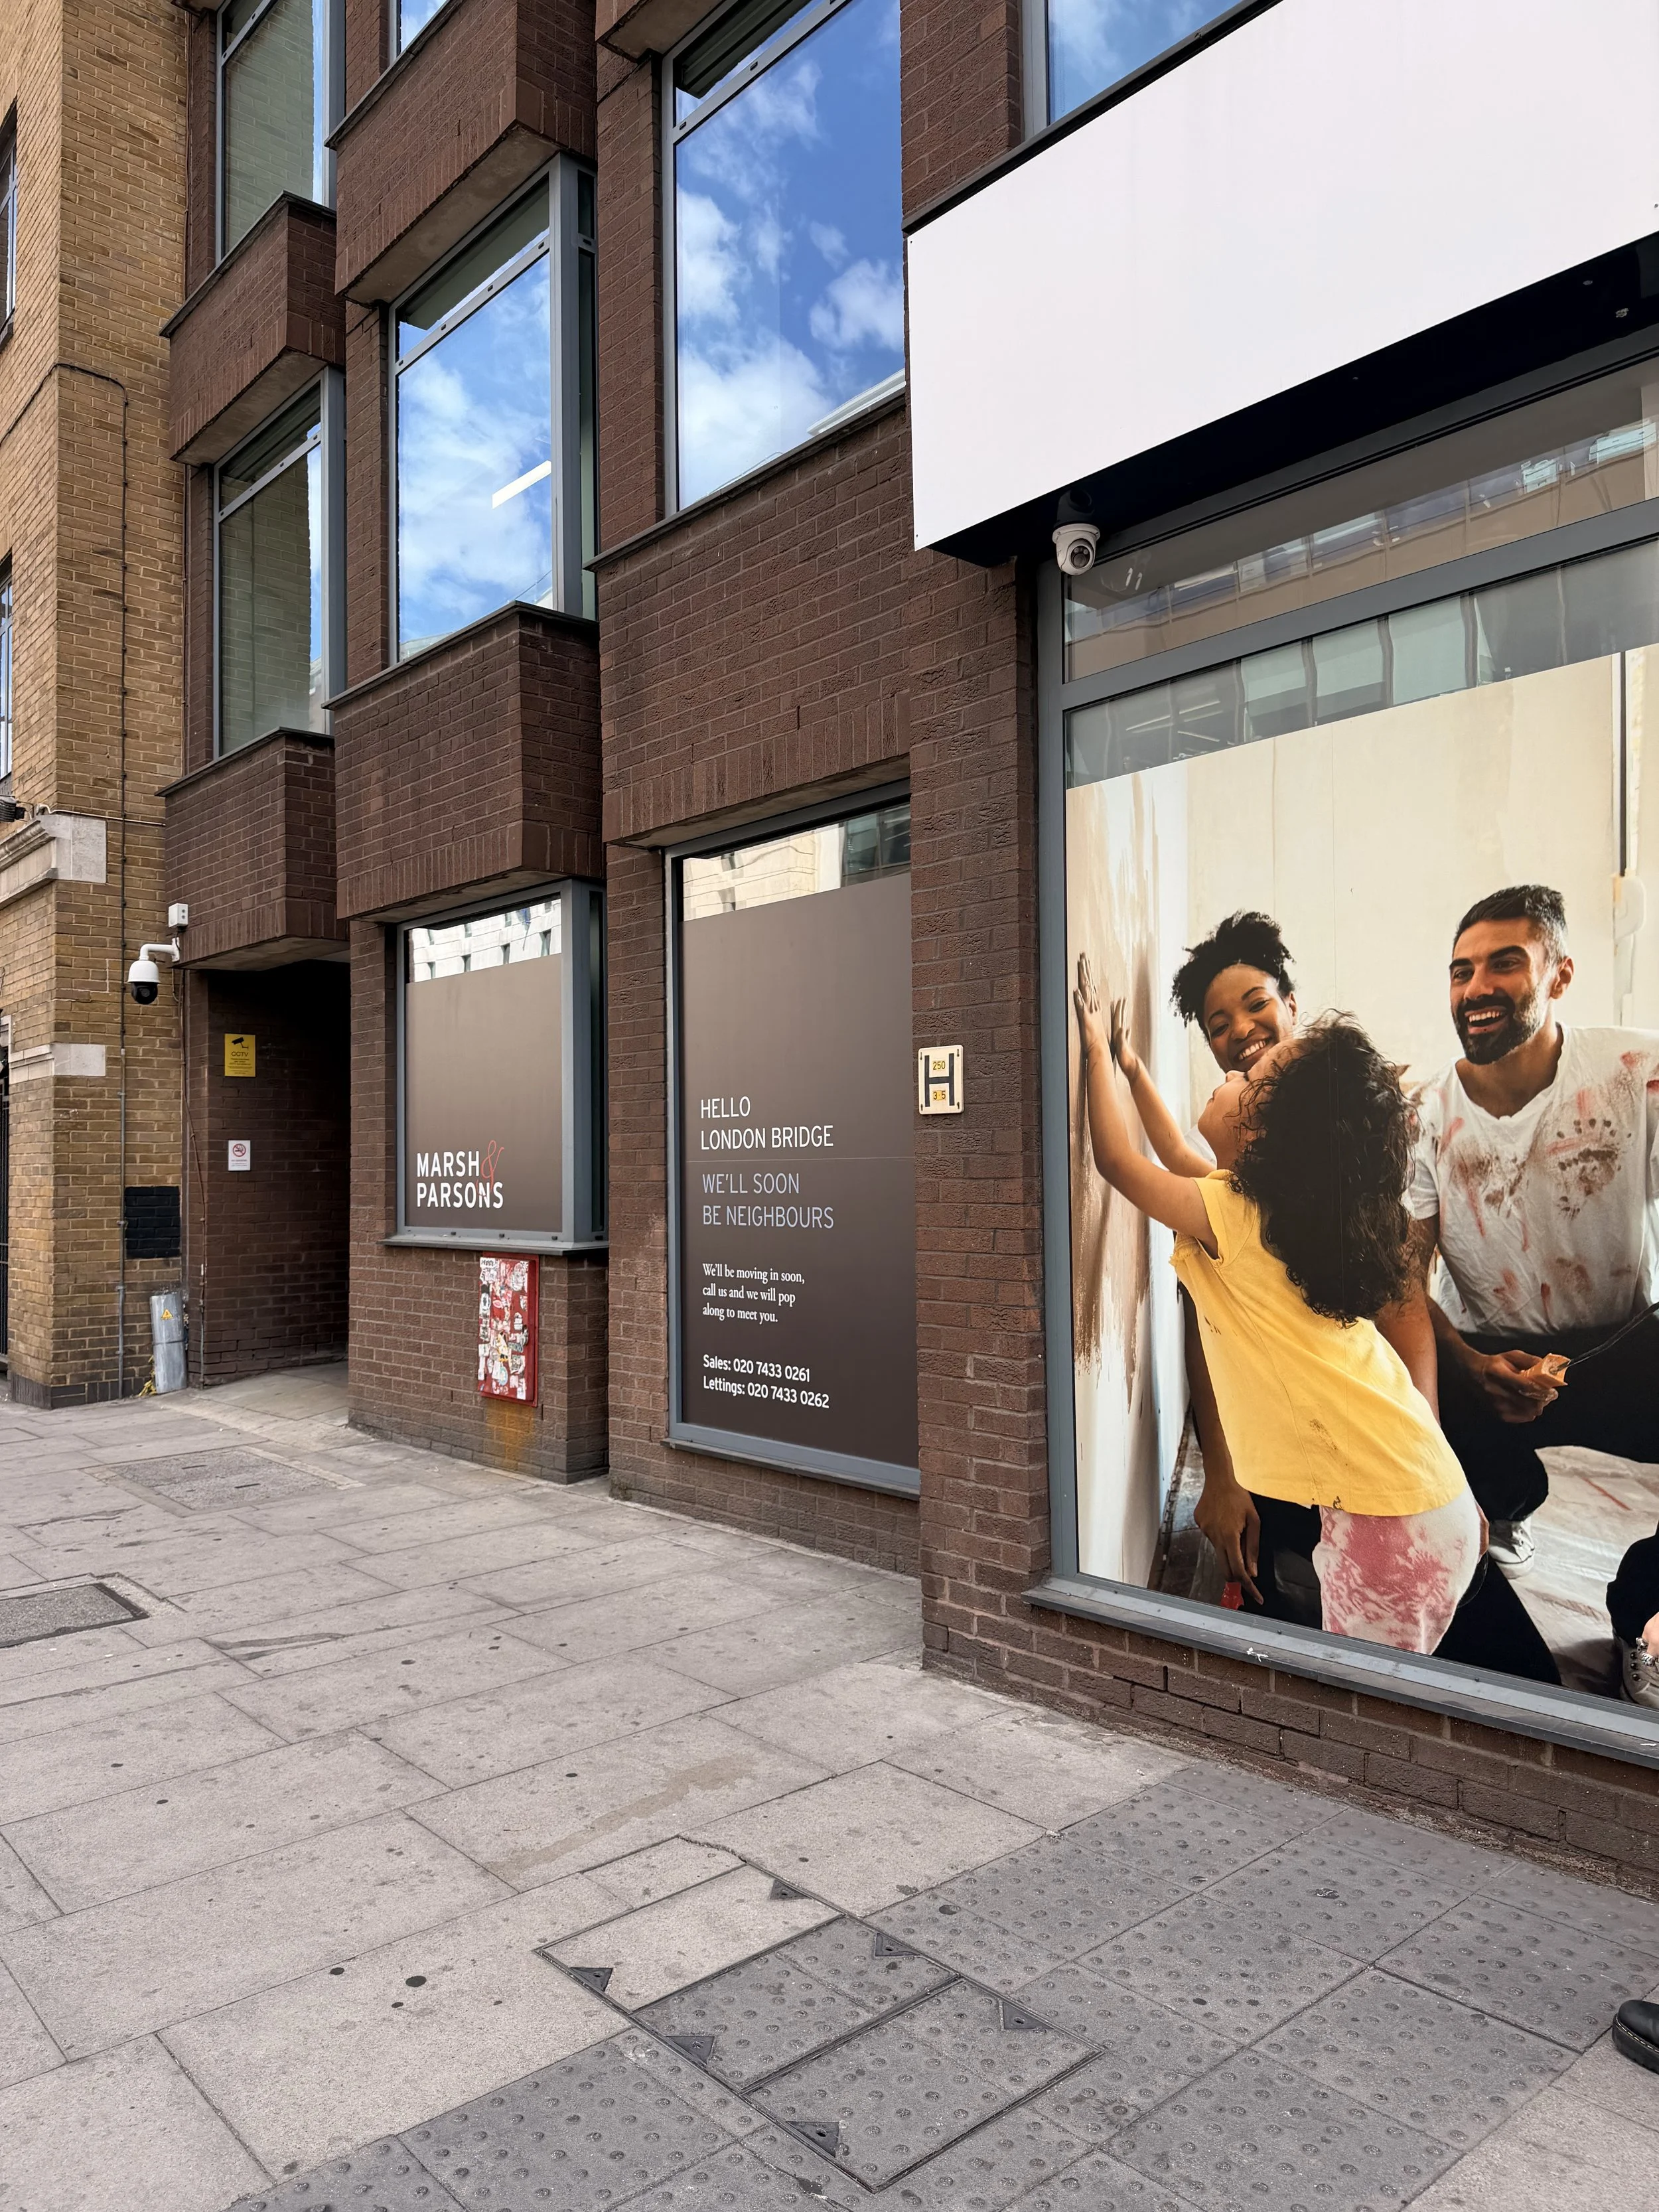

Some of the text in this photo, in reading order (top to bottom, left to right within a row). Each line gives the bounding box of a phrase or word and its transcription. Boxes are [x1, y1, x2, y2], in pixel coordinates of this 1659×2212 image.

[932, 1061, 946, 1070] 250
[924, 1053, 955, 1107] H
[701, 1096, 751, 1119] HELLO
[701, 1125, 834, 1150] LONDON BRIDGE
[417, 1140, 505, 1193] MARSH &
[417, 1181, 504, 1209] PARSONS
[702, 1173, 800, 1194] WE'LL SOON
[703, 1205, 834, 1229] BE NEIGHBOURS
[702, 1263, 805, 1285] We'll be moving in soon,
[702, 1282, 796, 1307] call us and we will pop
[702, 1302, 778, 1325] along to meet you.
[703, 1354, 810, 1382] Sales: 020 7433 0261
[703, 1375, 830, 1409] Lettings: 020 7433 0262
